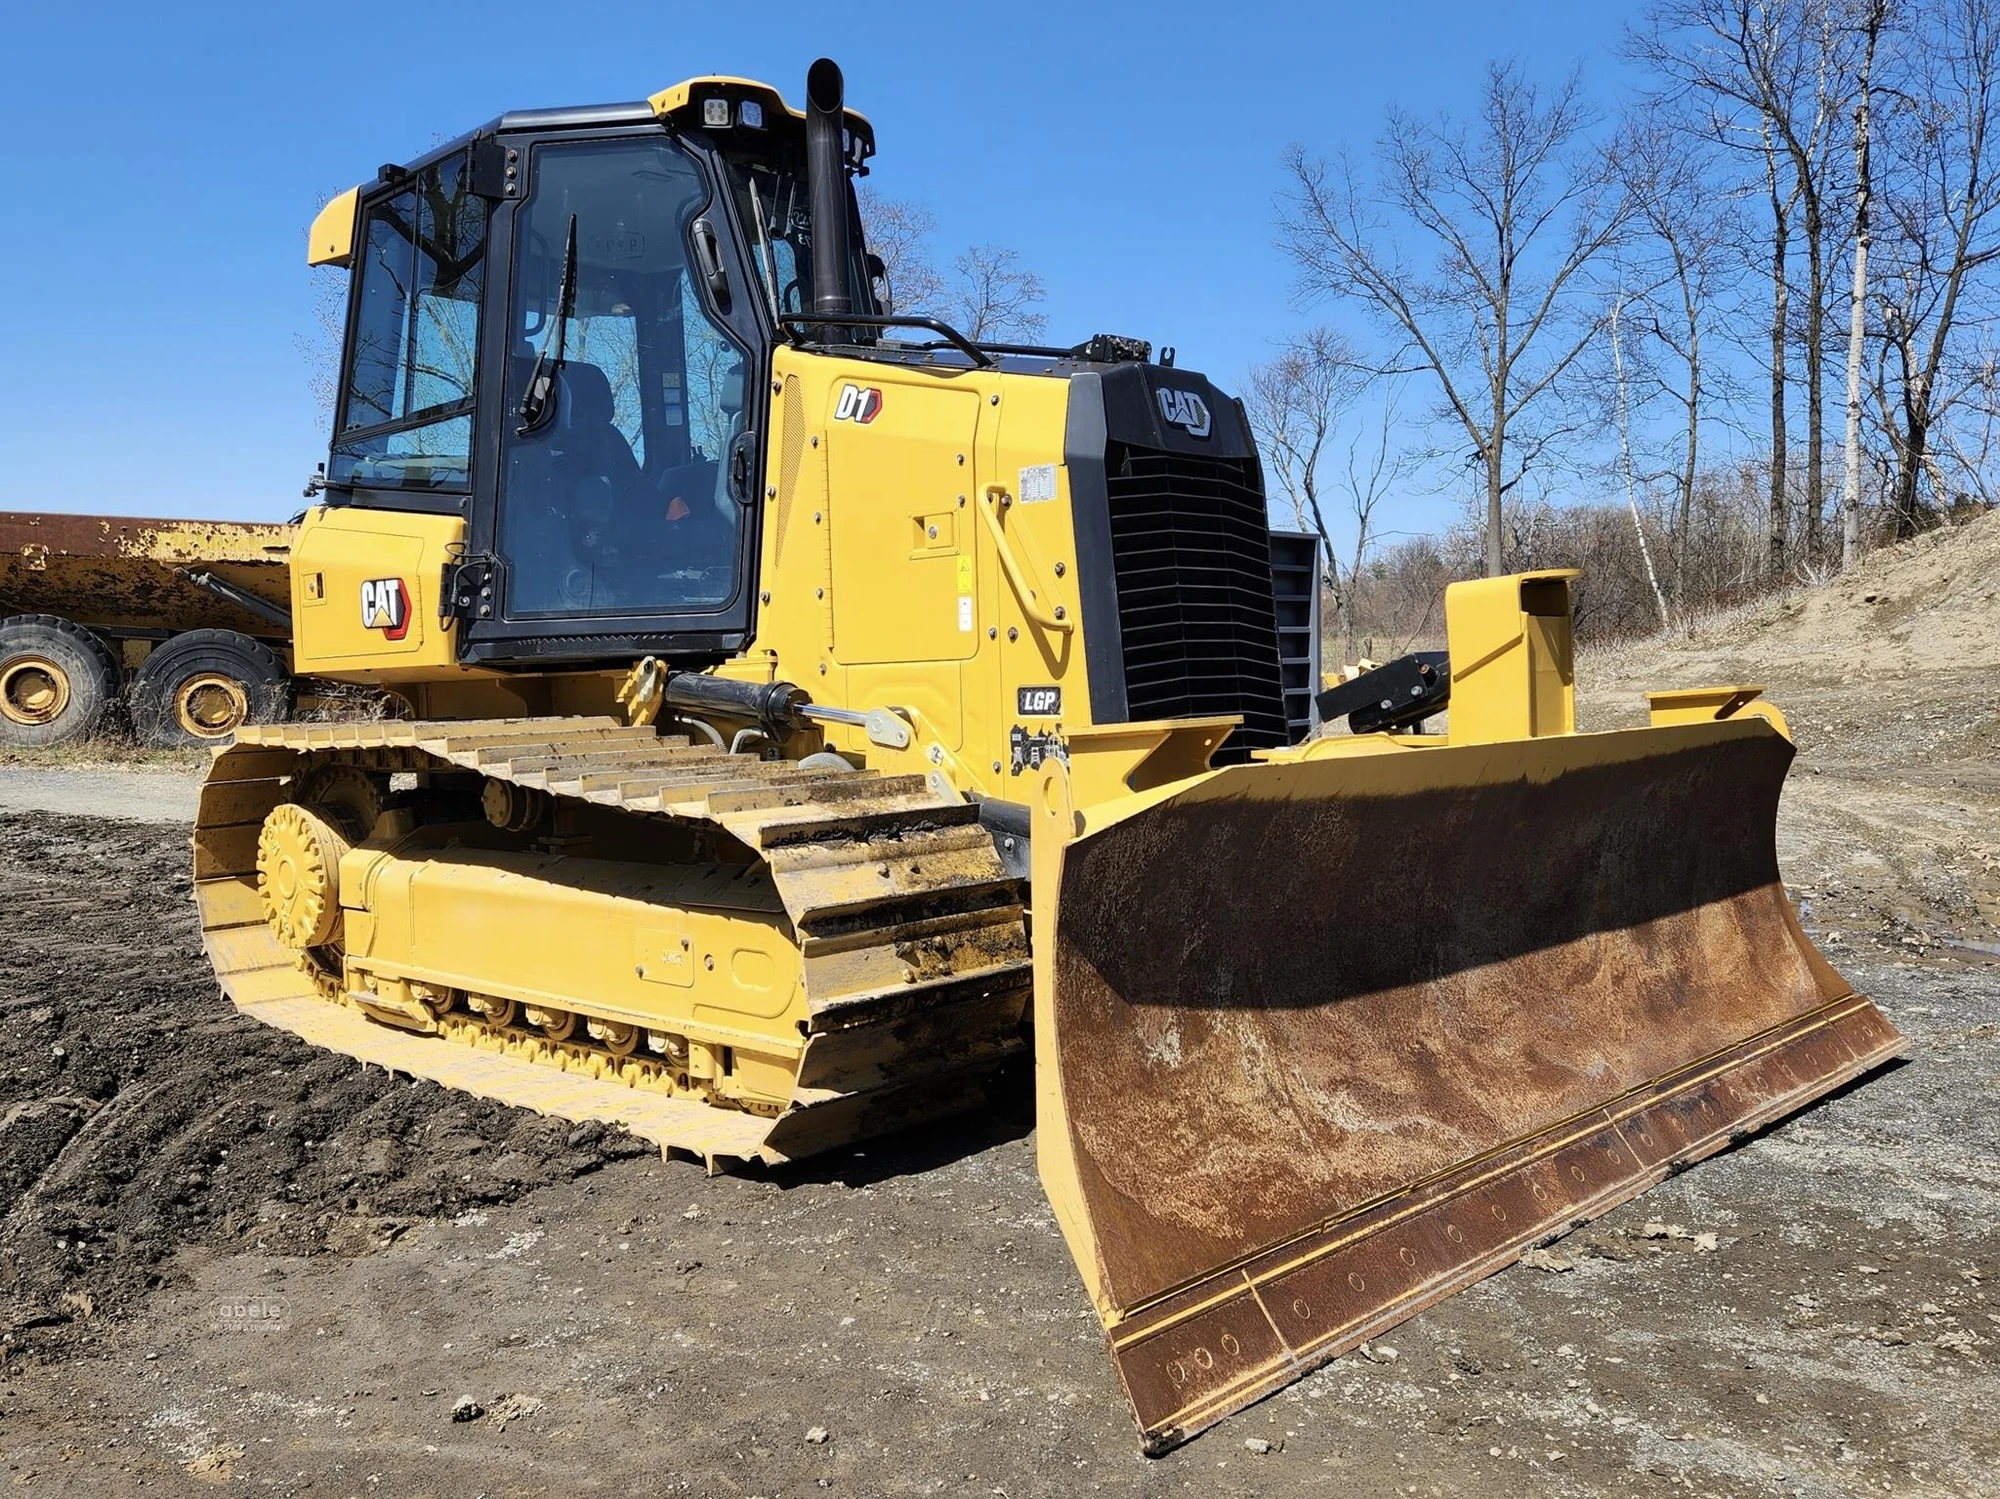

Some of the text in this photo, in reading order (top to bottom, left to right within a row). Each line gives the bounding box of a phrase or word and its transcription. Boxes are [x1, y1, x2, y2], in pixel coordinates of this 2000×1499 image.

[835, 384, 872, 422] D1
[1157, 387, 1200, 426] CAT
[361, 579, 399, 627] CAT
[1024, 691, 1056, 711] LGP
